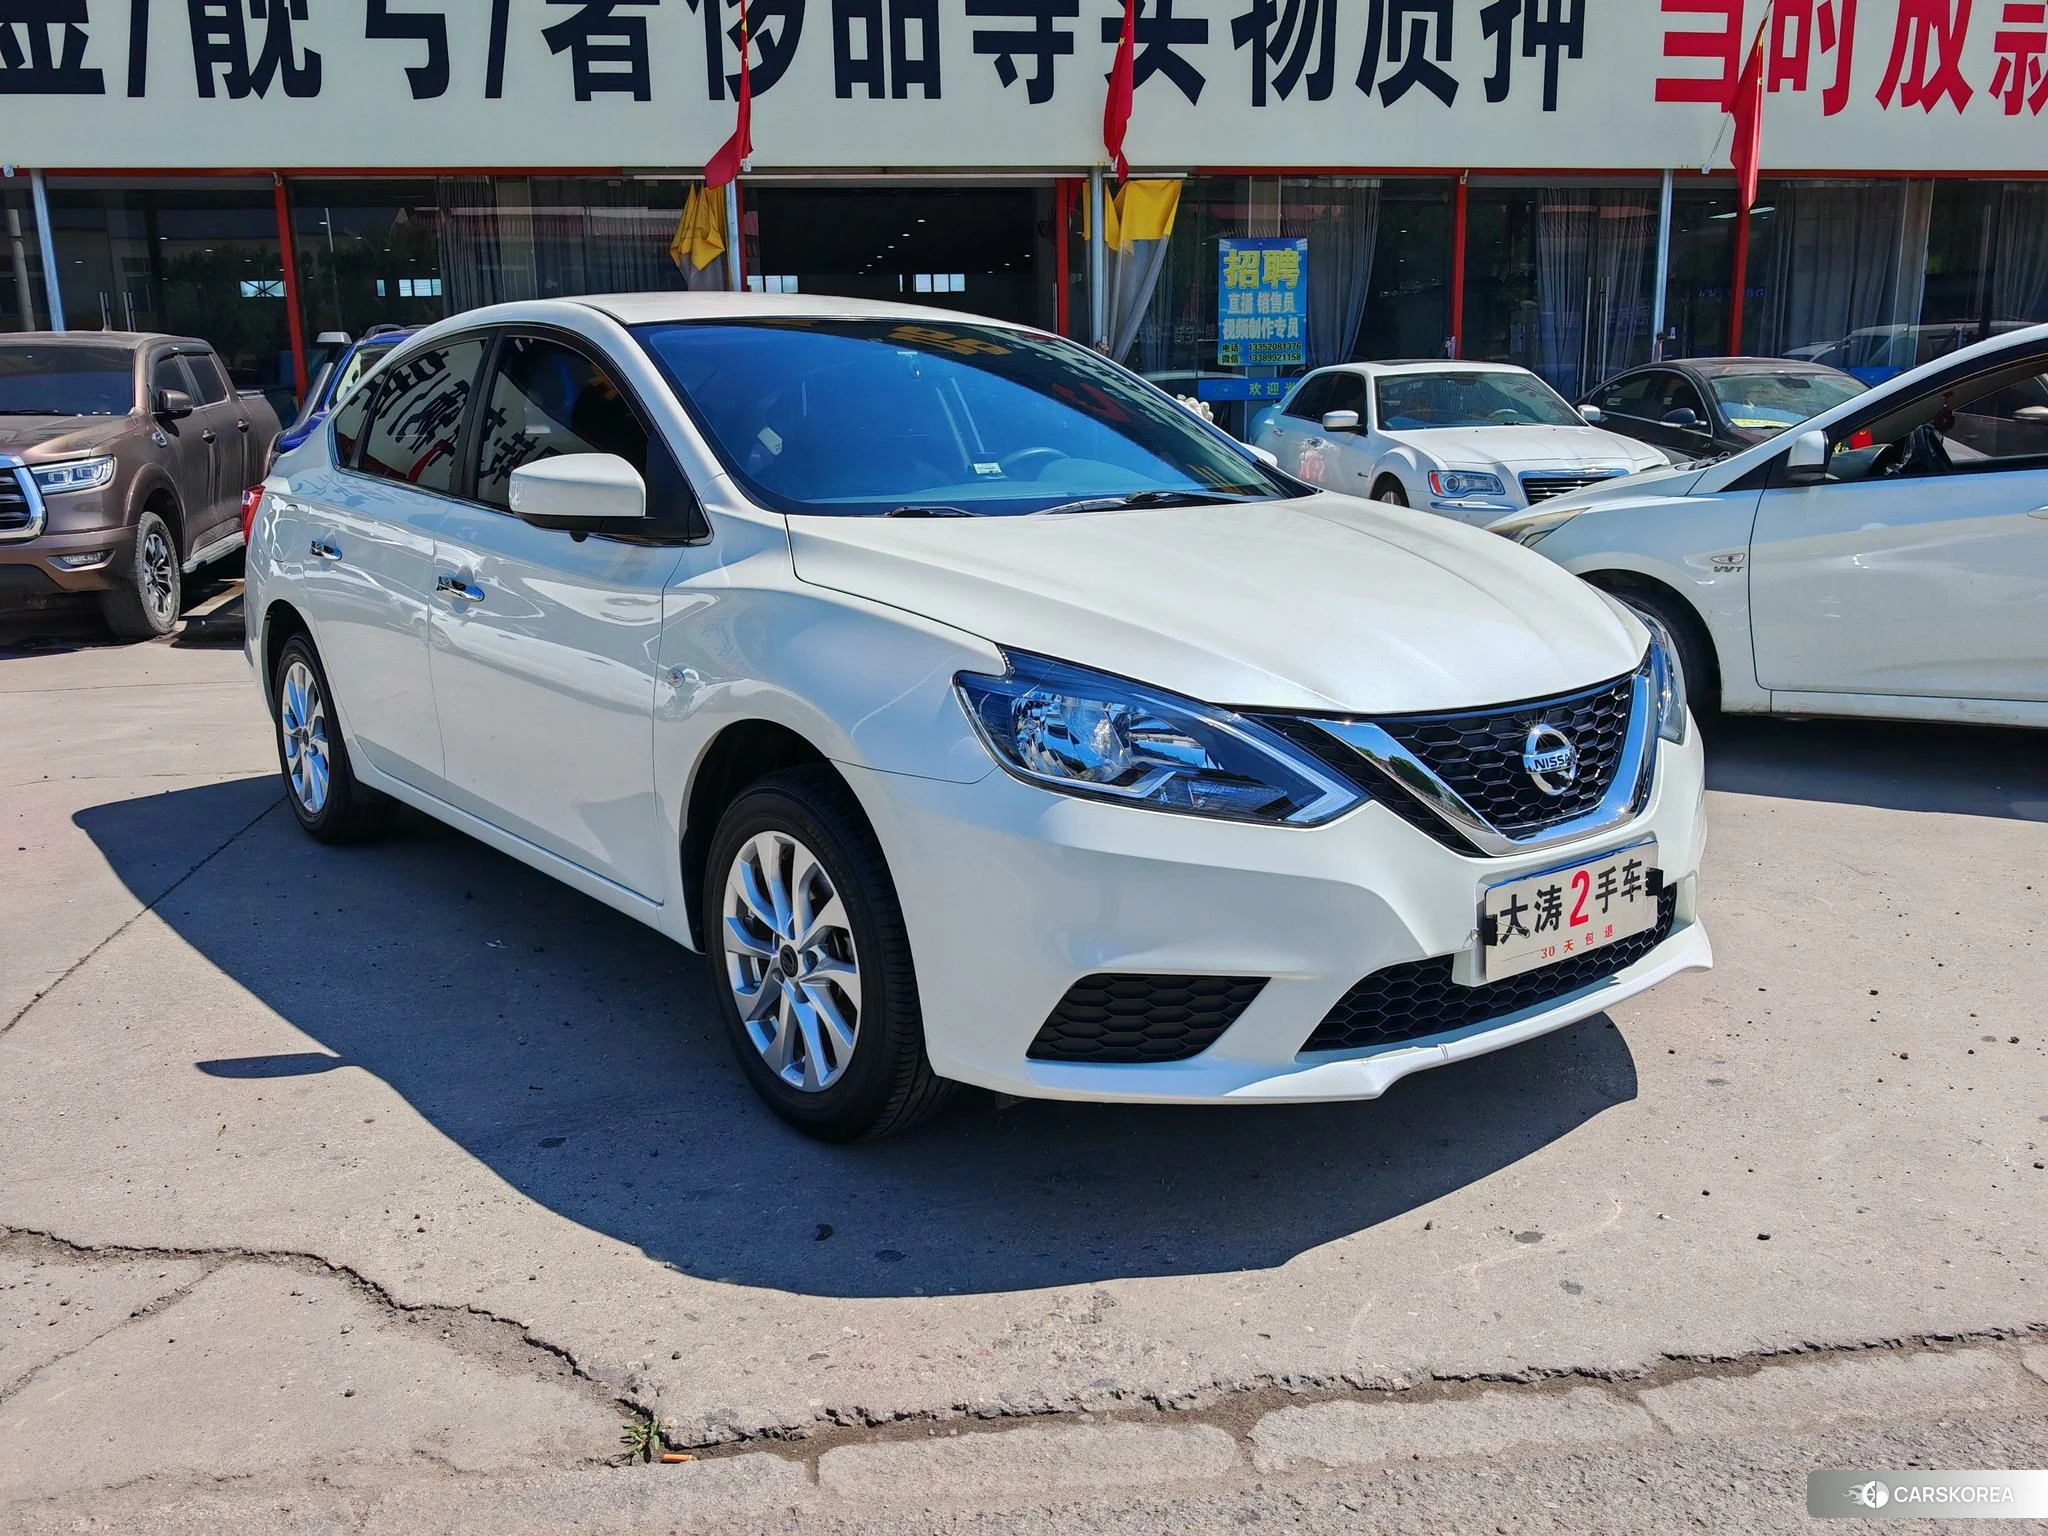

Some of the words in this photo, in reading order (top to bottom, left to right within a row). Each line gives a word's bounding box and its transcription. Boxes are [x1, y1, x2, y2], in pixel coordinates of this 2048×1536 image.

[1223, 248, 1300, 289] 招聘
[1228, 293, 1253, 314] 直播
[1257, 292, 1295, 314] 销售员
[1223, 317, 1299, 340] 视频制作专员
